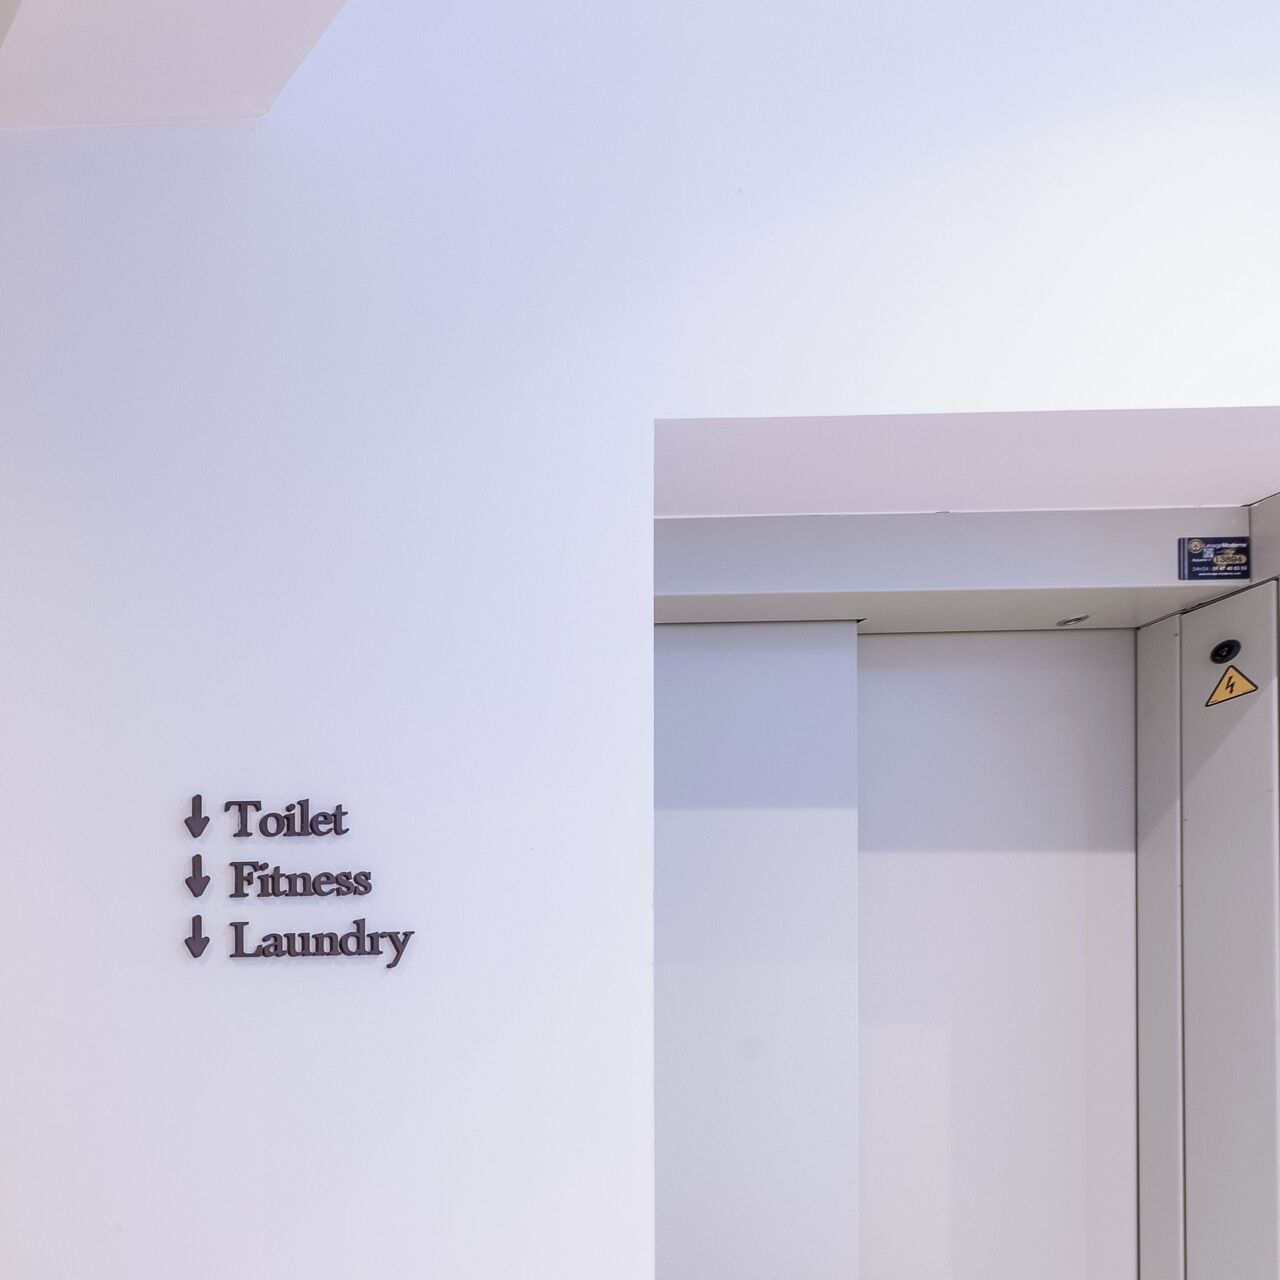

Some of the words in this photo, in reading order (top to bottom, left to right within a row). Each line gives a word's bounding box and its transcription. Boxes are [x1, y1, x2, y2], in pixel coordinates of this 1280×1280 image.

[224, 799, 349, 837] Toilet
[229, 861, 372, 898] Fitness
[229, 918, 415, 968] Laundry
